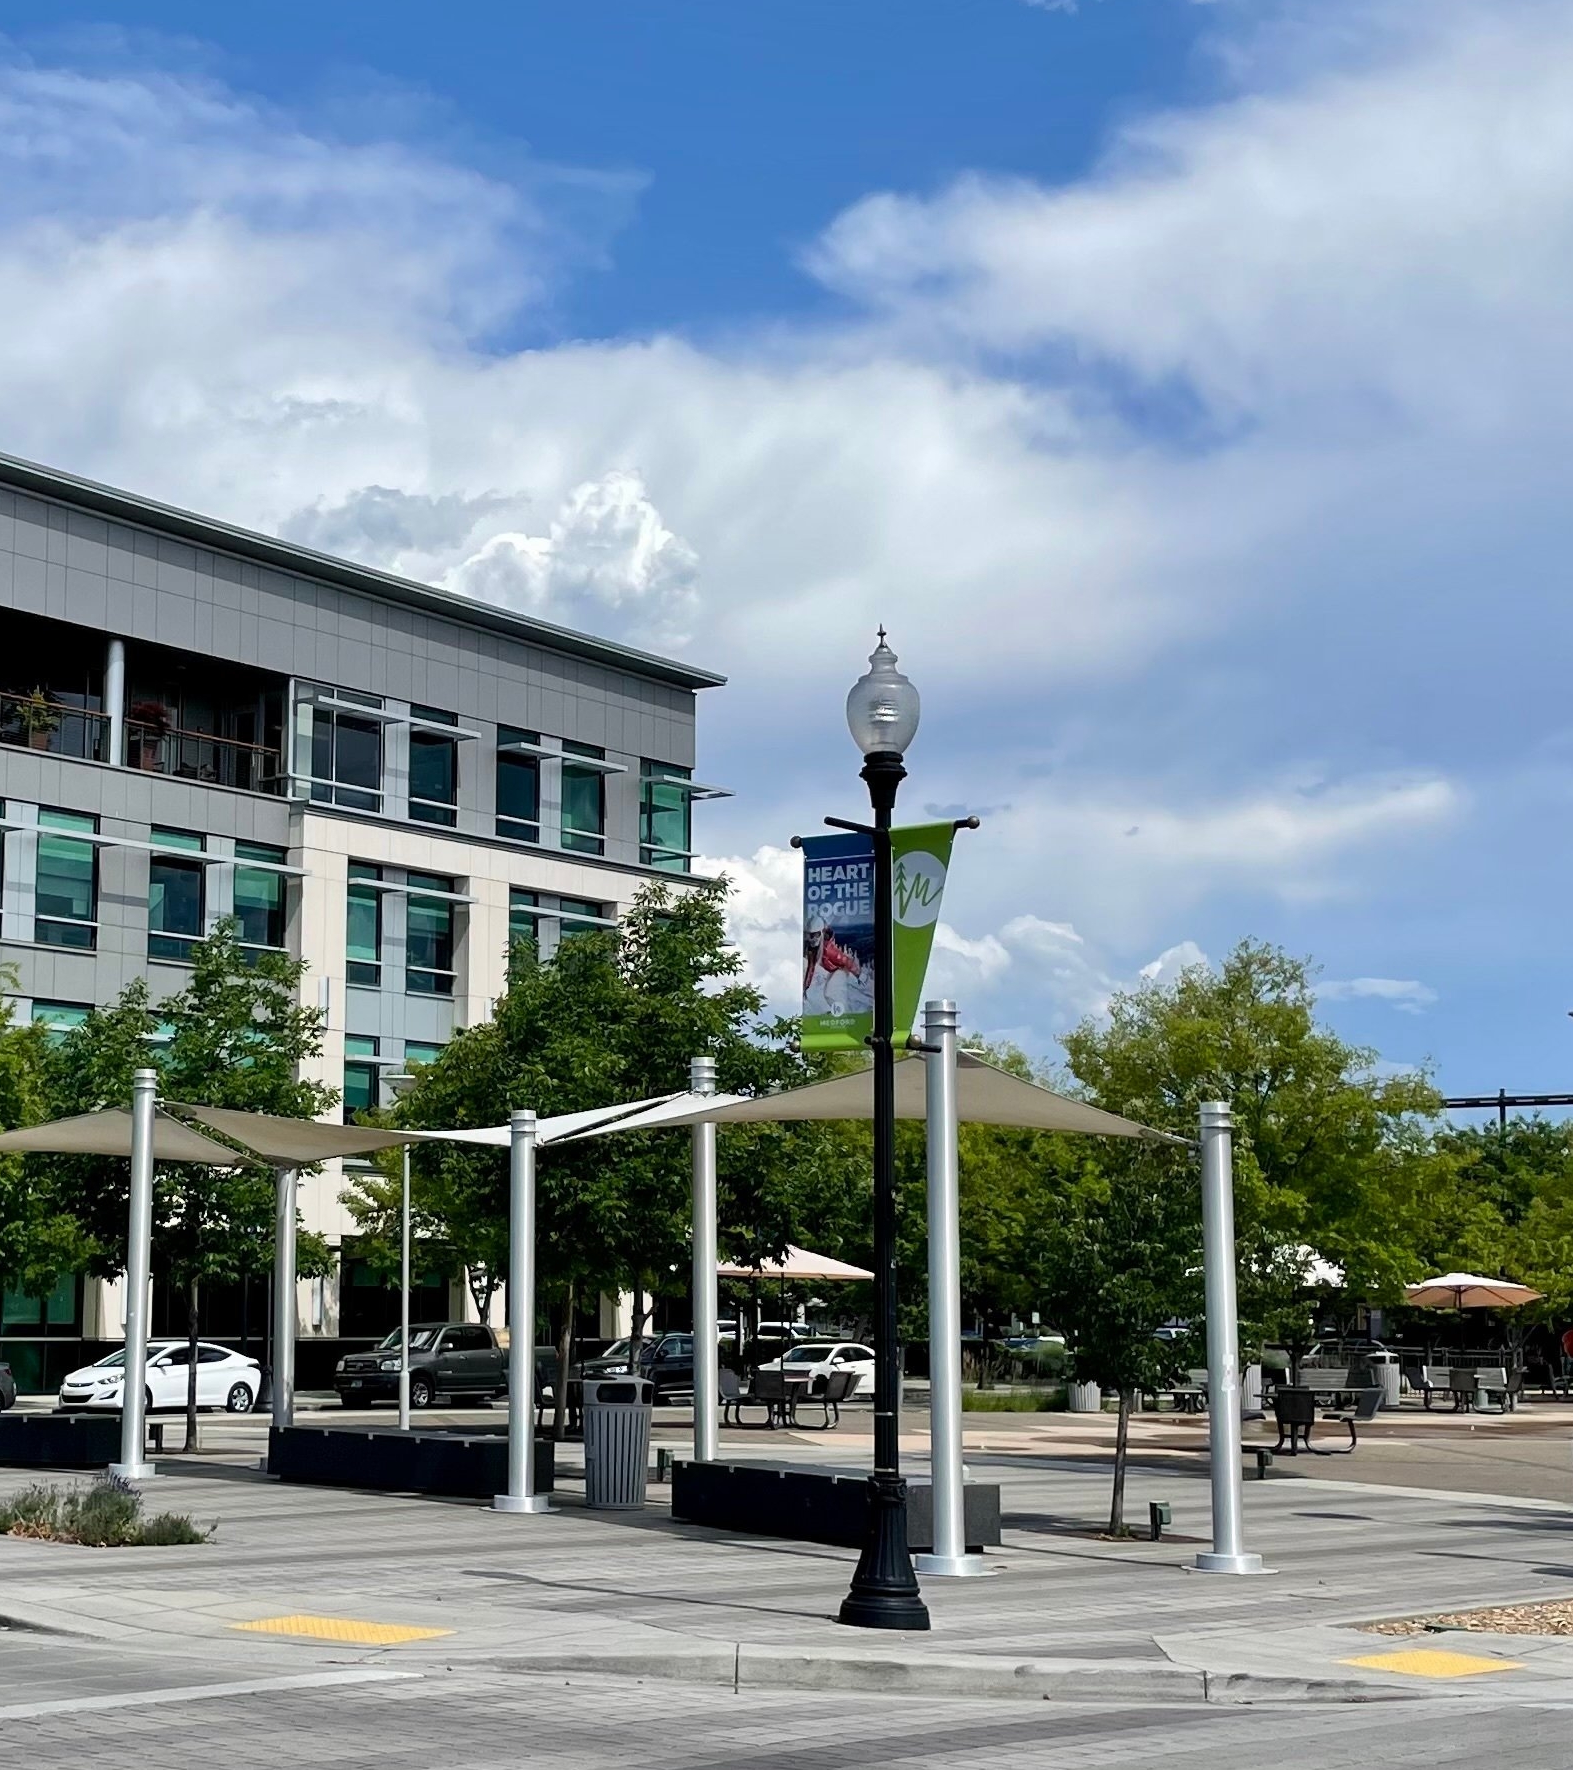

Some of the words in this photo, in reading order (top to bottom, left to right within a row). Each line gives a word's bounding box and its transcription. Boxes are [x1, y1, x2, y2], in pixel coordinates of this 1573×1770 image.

[808, 863, 870, 883] HEART
[808, 885, 832, 901] OF
[834, 882, 870, 899] THE
[808, 900, 870, 919] ROGUE
